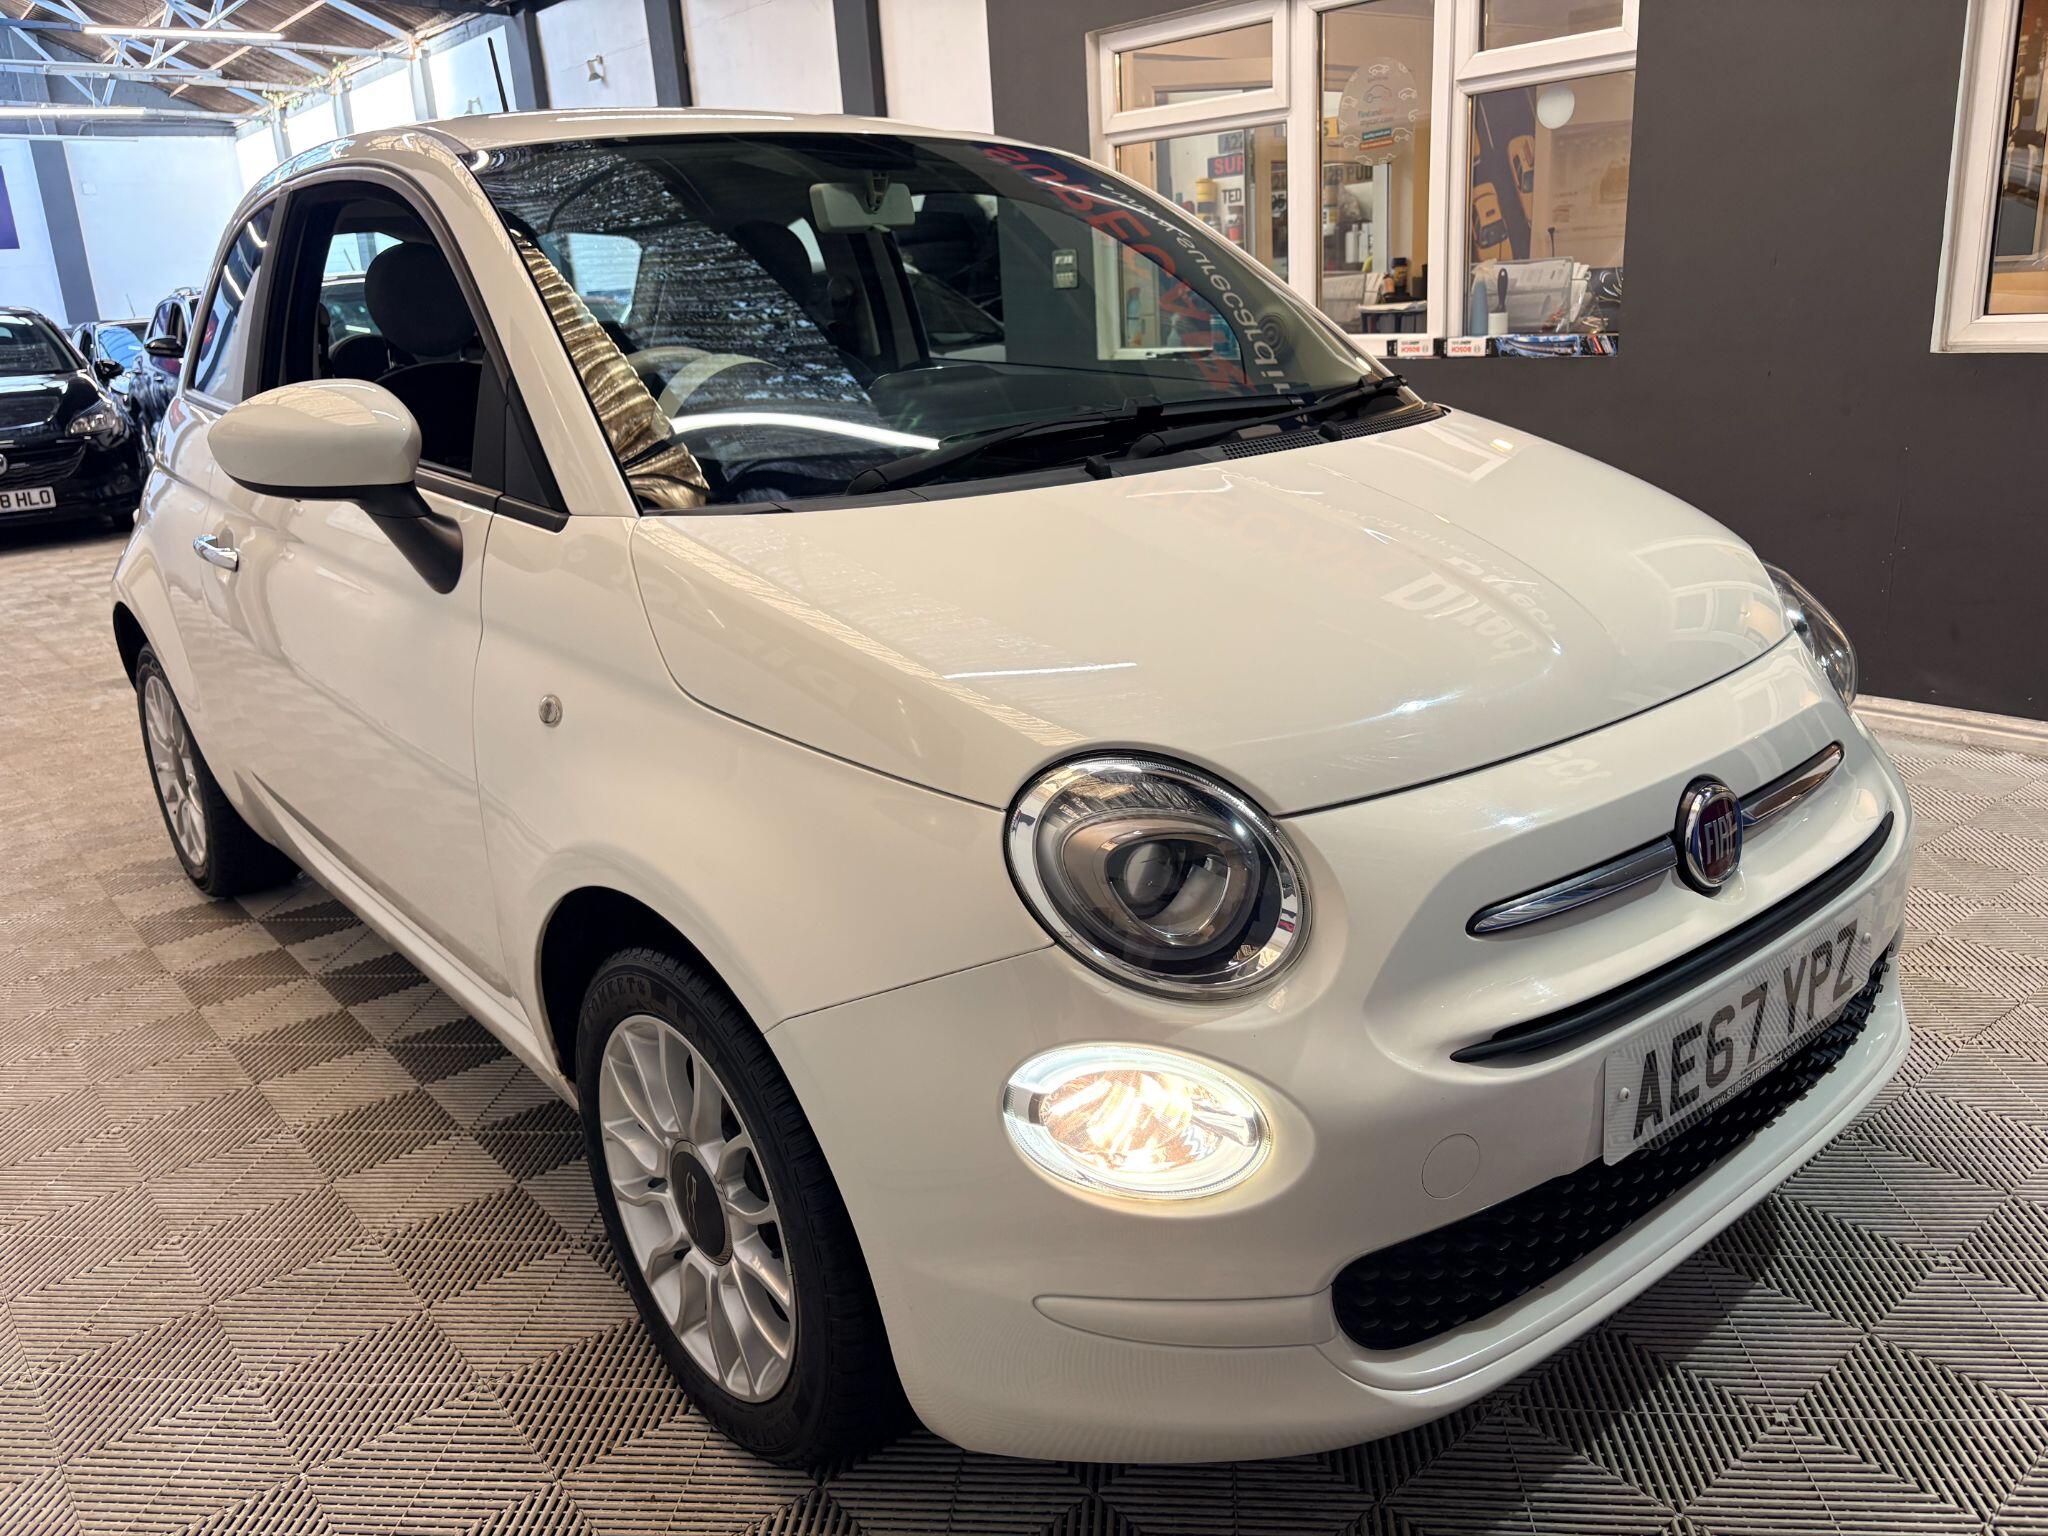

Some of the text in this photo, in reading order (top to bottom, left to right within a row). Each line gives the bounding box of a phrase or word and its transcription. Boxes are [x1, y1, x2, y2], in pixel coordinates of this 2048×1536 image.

[15, 489, 51, 507] HLO
[1703, 816, 1737, 864] FIAT
[1634, 917, 1859, 1140] AE67 YPZ
